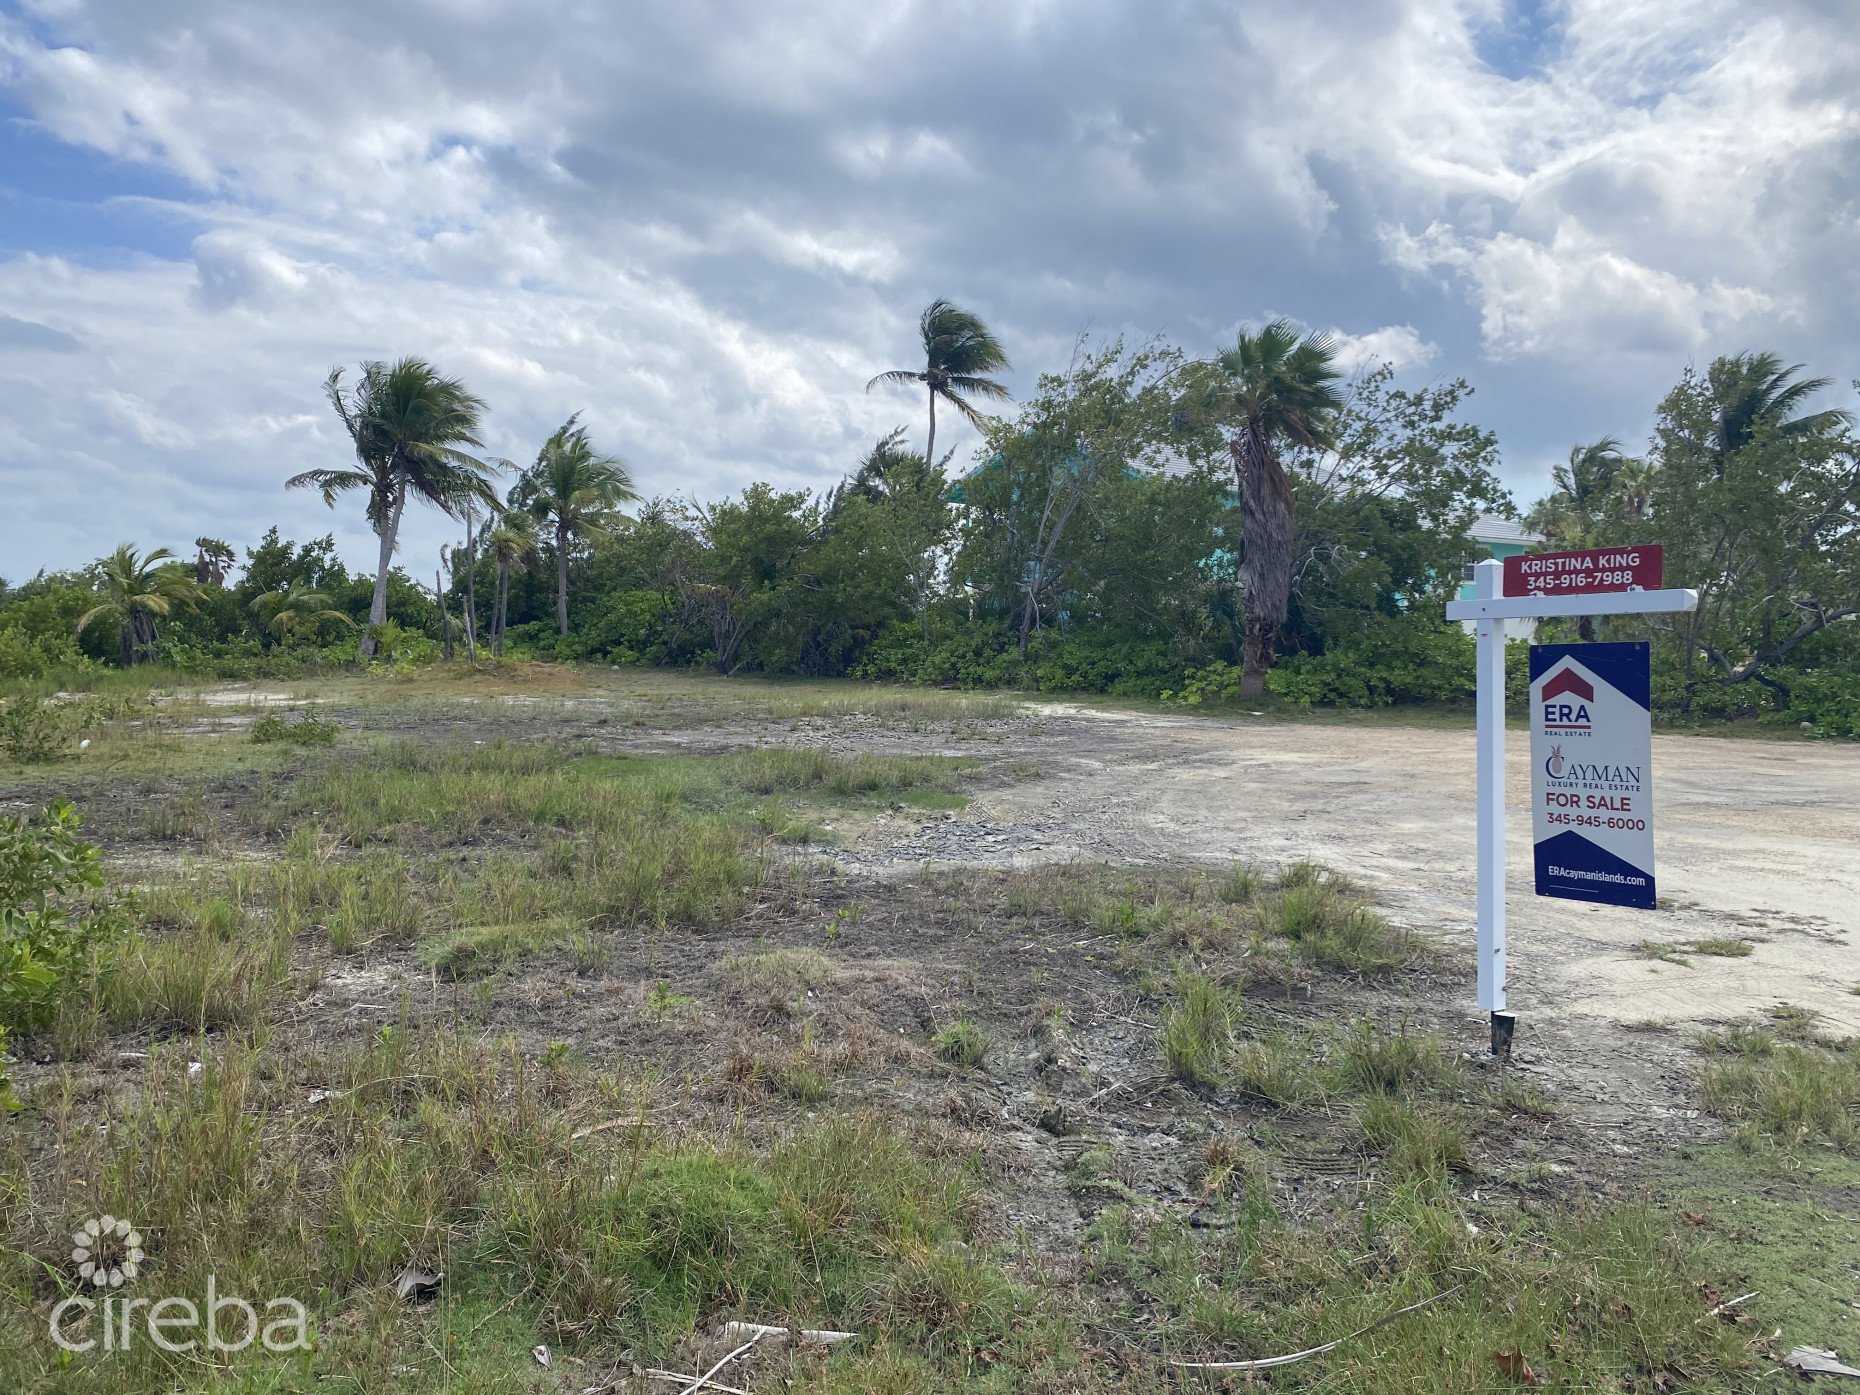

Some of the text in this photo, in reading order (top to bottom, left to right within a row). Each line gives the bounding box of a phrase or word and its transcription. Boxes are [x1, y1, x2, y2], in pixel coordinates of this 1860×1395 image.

[1521, 553, 1640, 574] KRISTINA KING
[1526, 570, 1633, 589] 345-916-7988
[1544, 704, 1591, 722] ERA
[1545, 755, 1642, 783] CAYMAN
[1546, 780, 1579, 788] LUXURY
[1608, 784, 1641, 792] ESTATE
[1546, 792, 1632, 812] FOR SALE
[1547, 812, 1646, 831] 345-945-6000
[1548, 865, 1646, 886] ERAcaymanislands.com
